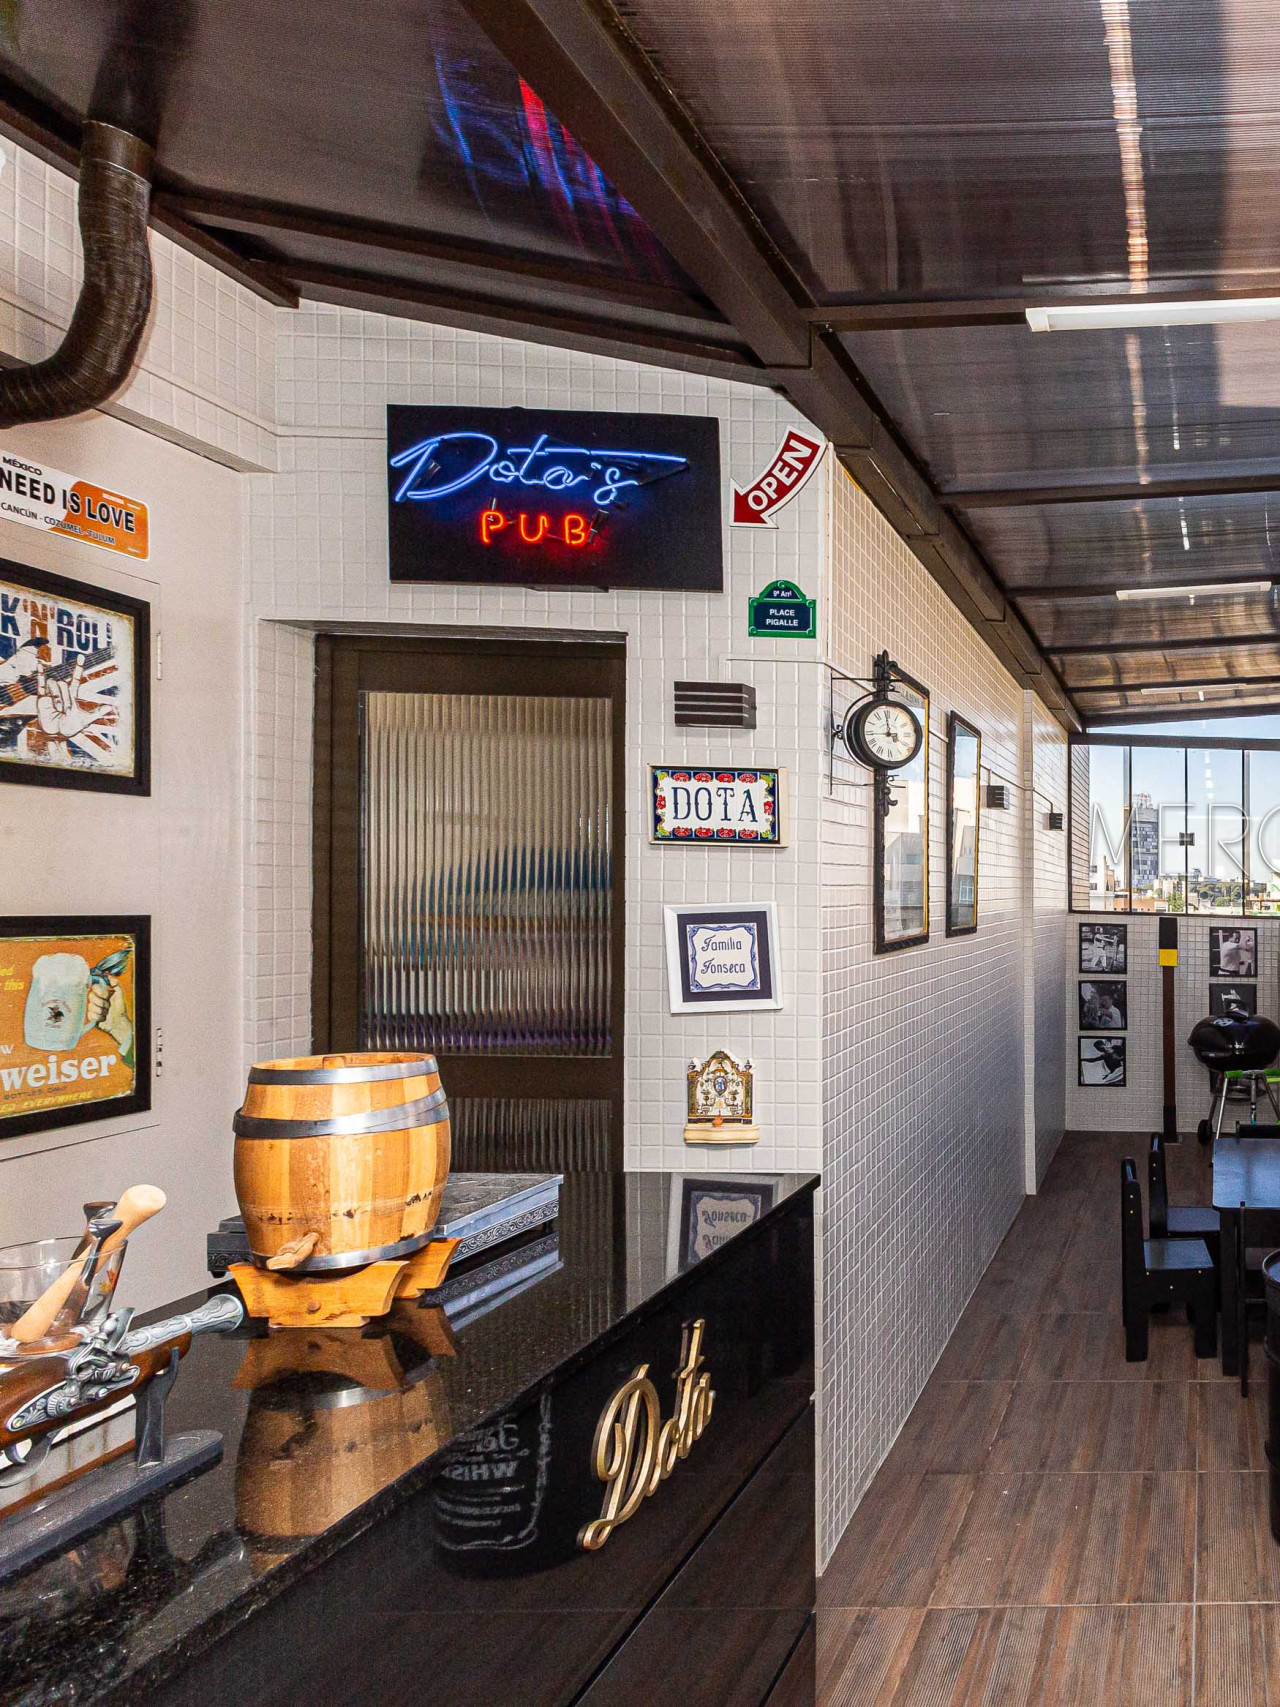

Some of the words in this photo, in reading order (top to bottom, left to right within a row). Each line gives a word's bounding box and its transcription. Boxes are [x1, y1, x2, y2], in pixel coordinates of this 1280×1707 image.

[2, 456, 42, 476] MÉXICO
[748, 439, 813, 511] OPEN
[0, 466, 55, 505] NEED
[62, 488, 81, 514] IS
[85, 497, 135, 533] LOVE
[44, 516, 83, 535] COZUMEL
[480, 511, 587, 545] PUB
[769, 609, 795, 617] PLACE
[766, 619, 799, 627] PIGALLE
[671, 787, 758, 823] DOTA
[701, 934, 742, 952] Familia
[701, 957, 746, 975] Fonseca
